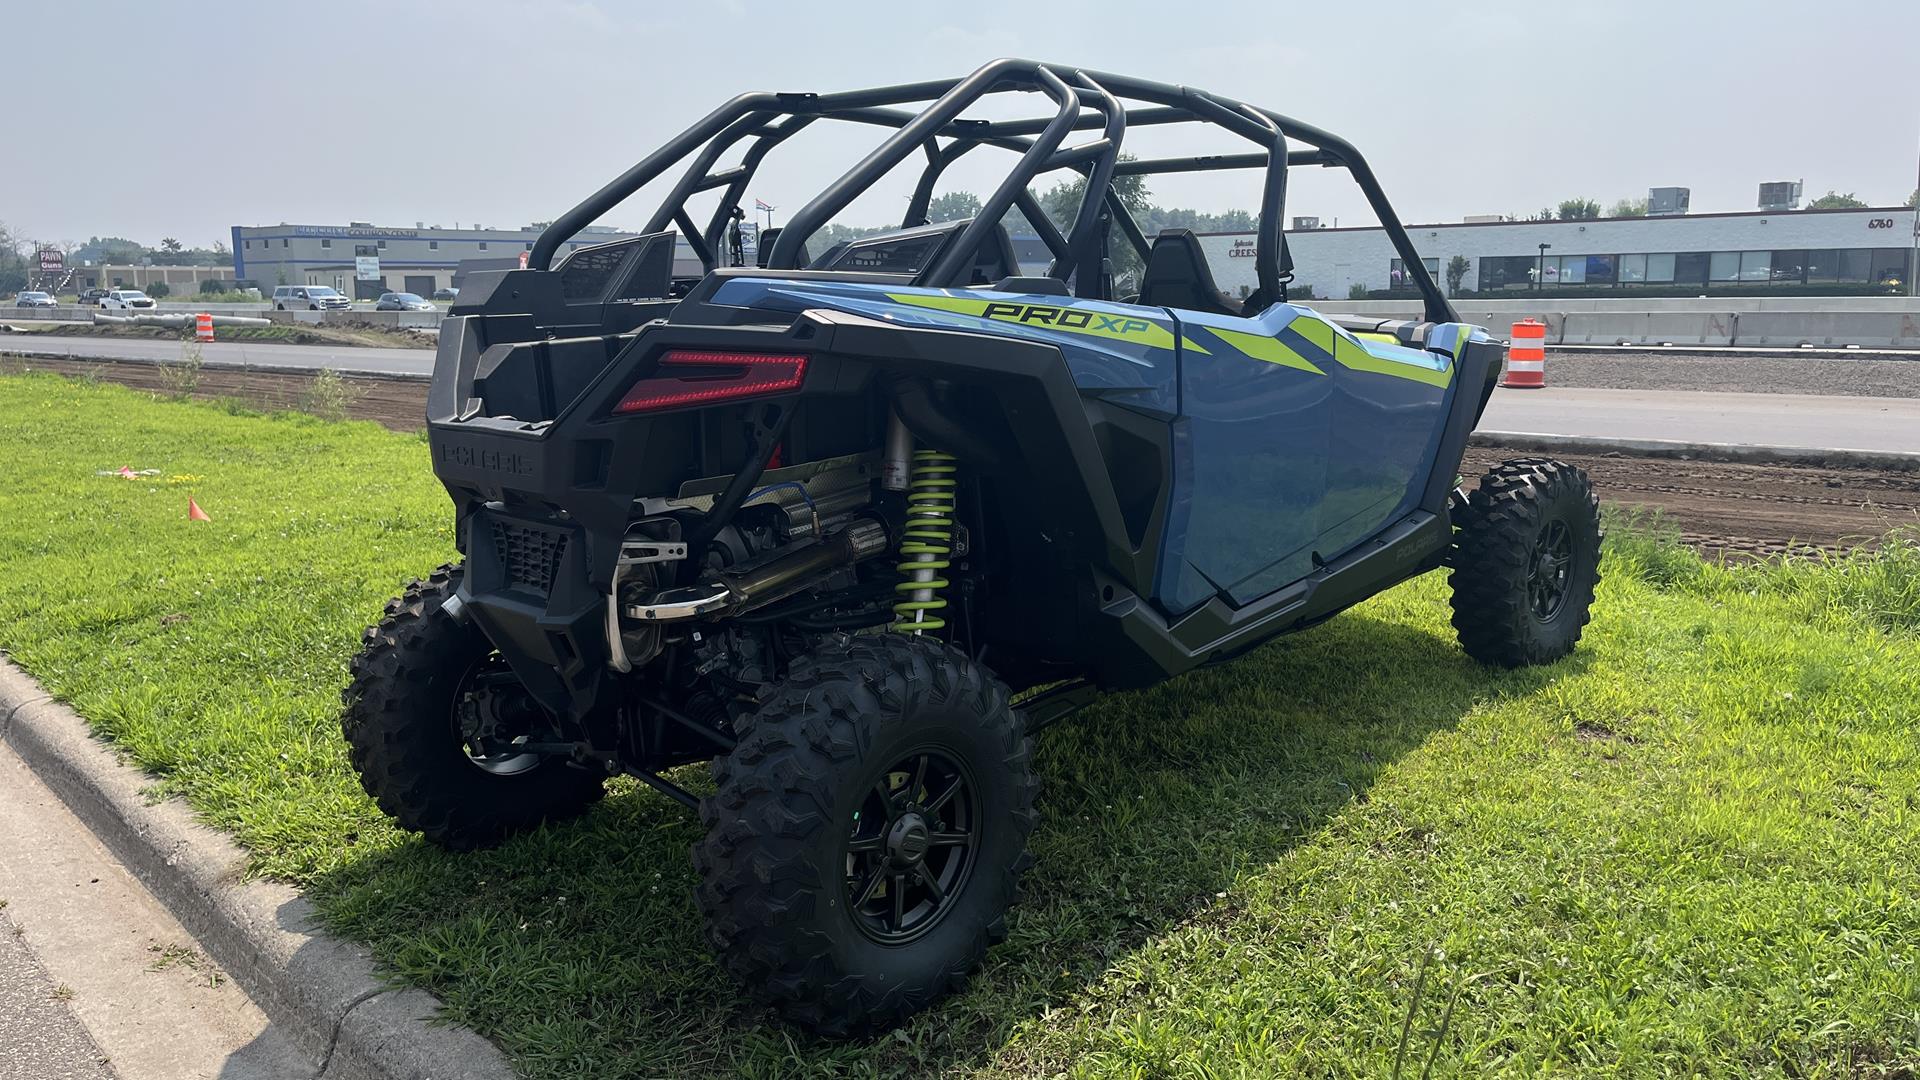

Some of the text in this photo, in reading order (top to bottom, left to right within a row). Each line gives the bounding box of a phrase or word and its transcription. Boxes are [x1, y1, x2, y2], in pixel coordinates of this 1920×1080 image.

[1868, 219, 1893, 228] 6760
[40, 251, 62, 261] PAWN
[981, 303, 1151, 334] PRO XP
[441, 443, 534, 475] POLARIS
